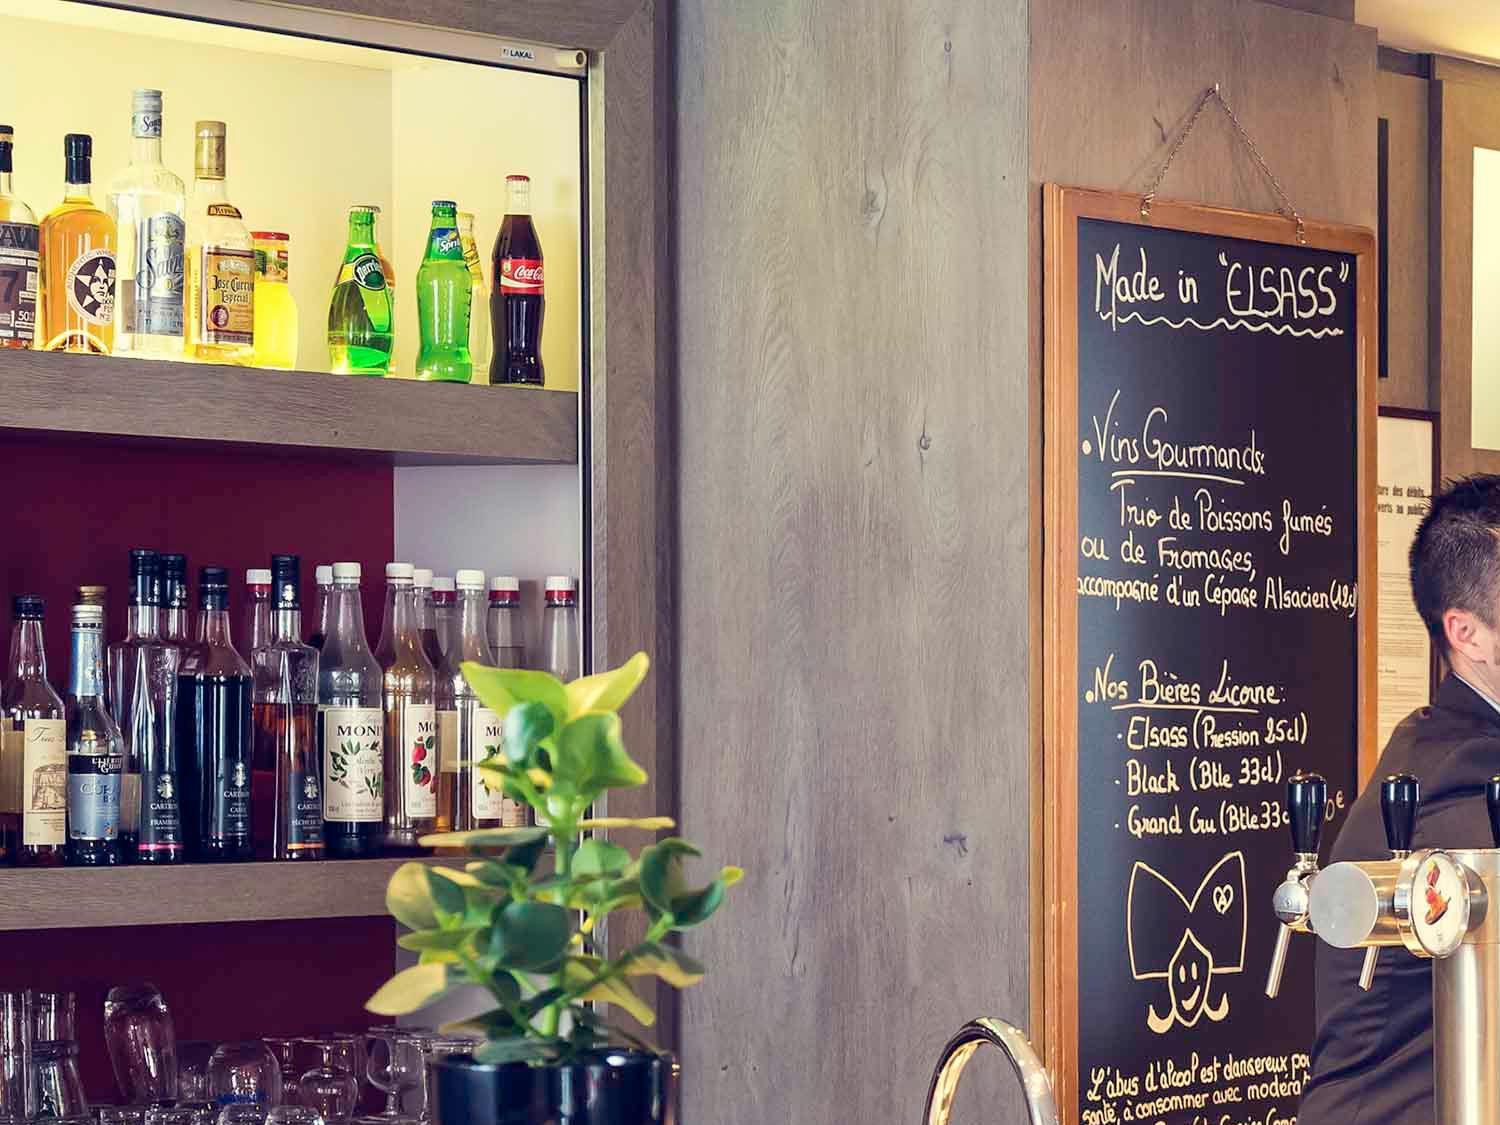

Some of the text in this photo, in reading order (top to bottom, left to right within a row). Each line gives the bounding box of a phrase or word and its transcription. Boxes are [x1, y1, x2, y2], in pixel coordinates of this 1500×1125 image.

[440, 240, 459, 254] Spri
[1095, 244, 1165, 331] Made
[1178, 270, 1199, 304] in
[1093, 389, 1138, 464] Vins
[1110, 479, 1333, 555] Trio de Poissons fumés
[1081, 535, 1109, 561] ou
[1120, 530, 1147, 564] de
[1166, 575, 1201, 606] d'un
[1204, 574, 1257, 616] Cépage
[1264, 576, 1330, 609] Alsacien
[1094, 653, 1129, 702] Nos
[1138, 659, 1201, 704] Bières
[1127, 708, 1308, 750] Elsass (Pression 25cl)
[1126, 750, 1282, 796] Black (Btle 33cl)
[1128, 804, 1183, 838] Grand
[1220, 800, 1259, 835] (Btle
[1260, 800, 1290, 830] 33c
[1087, 1052, 1311, 1101] L'abus d'alcool est dangereux po
[1124, 1099, 1134, 1121] à
[1135, 1091, 1210, 1119] consommer
[1212, 1088, 1243, 1105] avec
[1247, 1070, 1311, 1100] modérat
